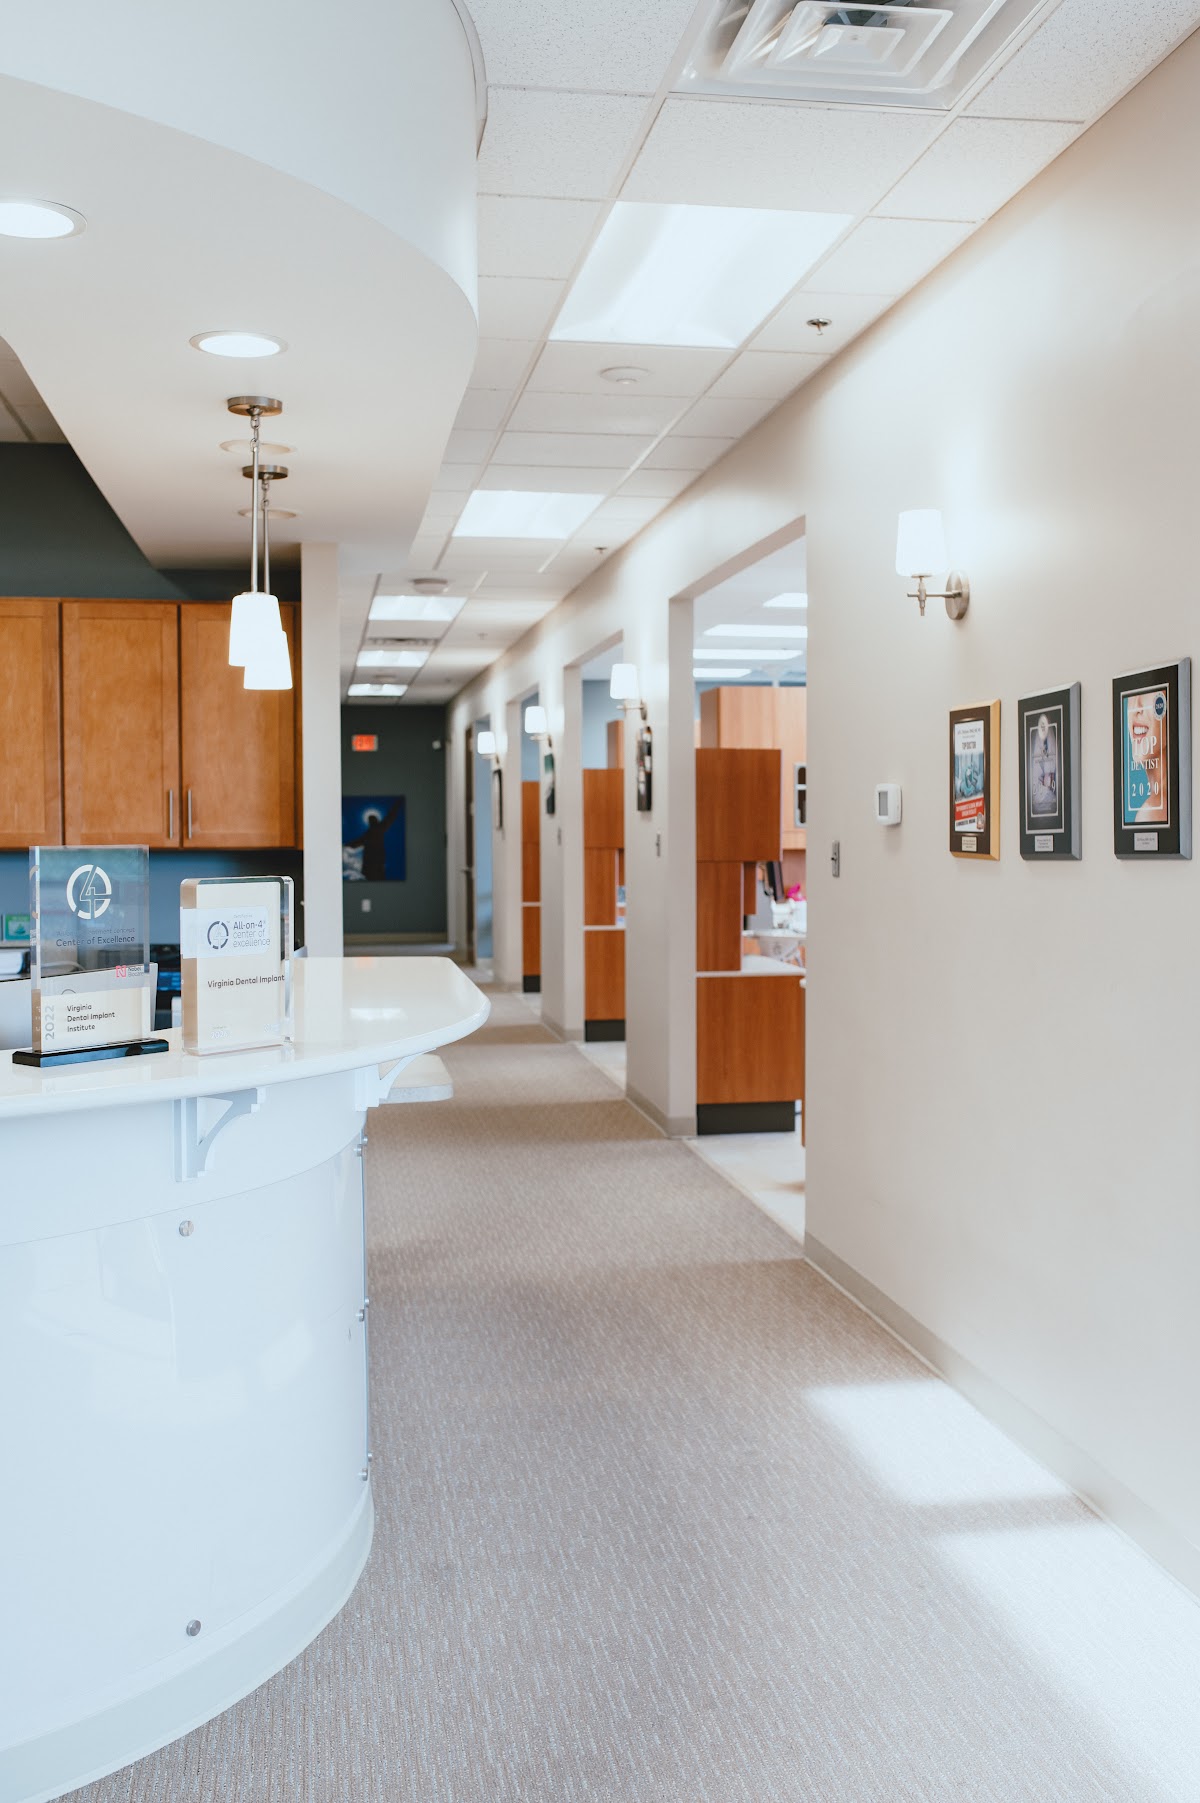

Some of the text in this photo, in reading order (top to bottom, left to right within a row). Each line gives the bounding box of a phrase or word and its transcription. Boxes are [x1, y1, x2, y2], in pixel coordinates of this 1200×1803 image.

[1134, 735, 1157, 756] TOP
[1130, 757, 1160, 772] DENTIST
[1131, 781, 1159, 798] 2020
[232, 927, 266, 939] center of
[55, 935, 135, 947] Center of Excellence
[232, 937, 271, 948] excellence
[207, 974, 285, 989] Virginia Dental Implant
[66, 1003, 92, 1013] Virginia
[44, 1004, 55, 1041] 2022
[66, 1011, 116, 1023] Dental Implant
[66, 1024, 96, 1033] Institute
